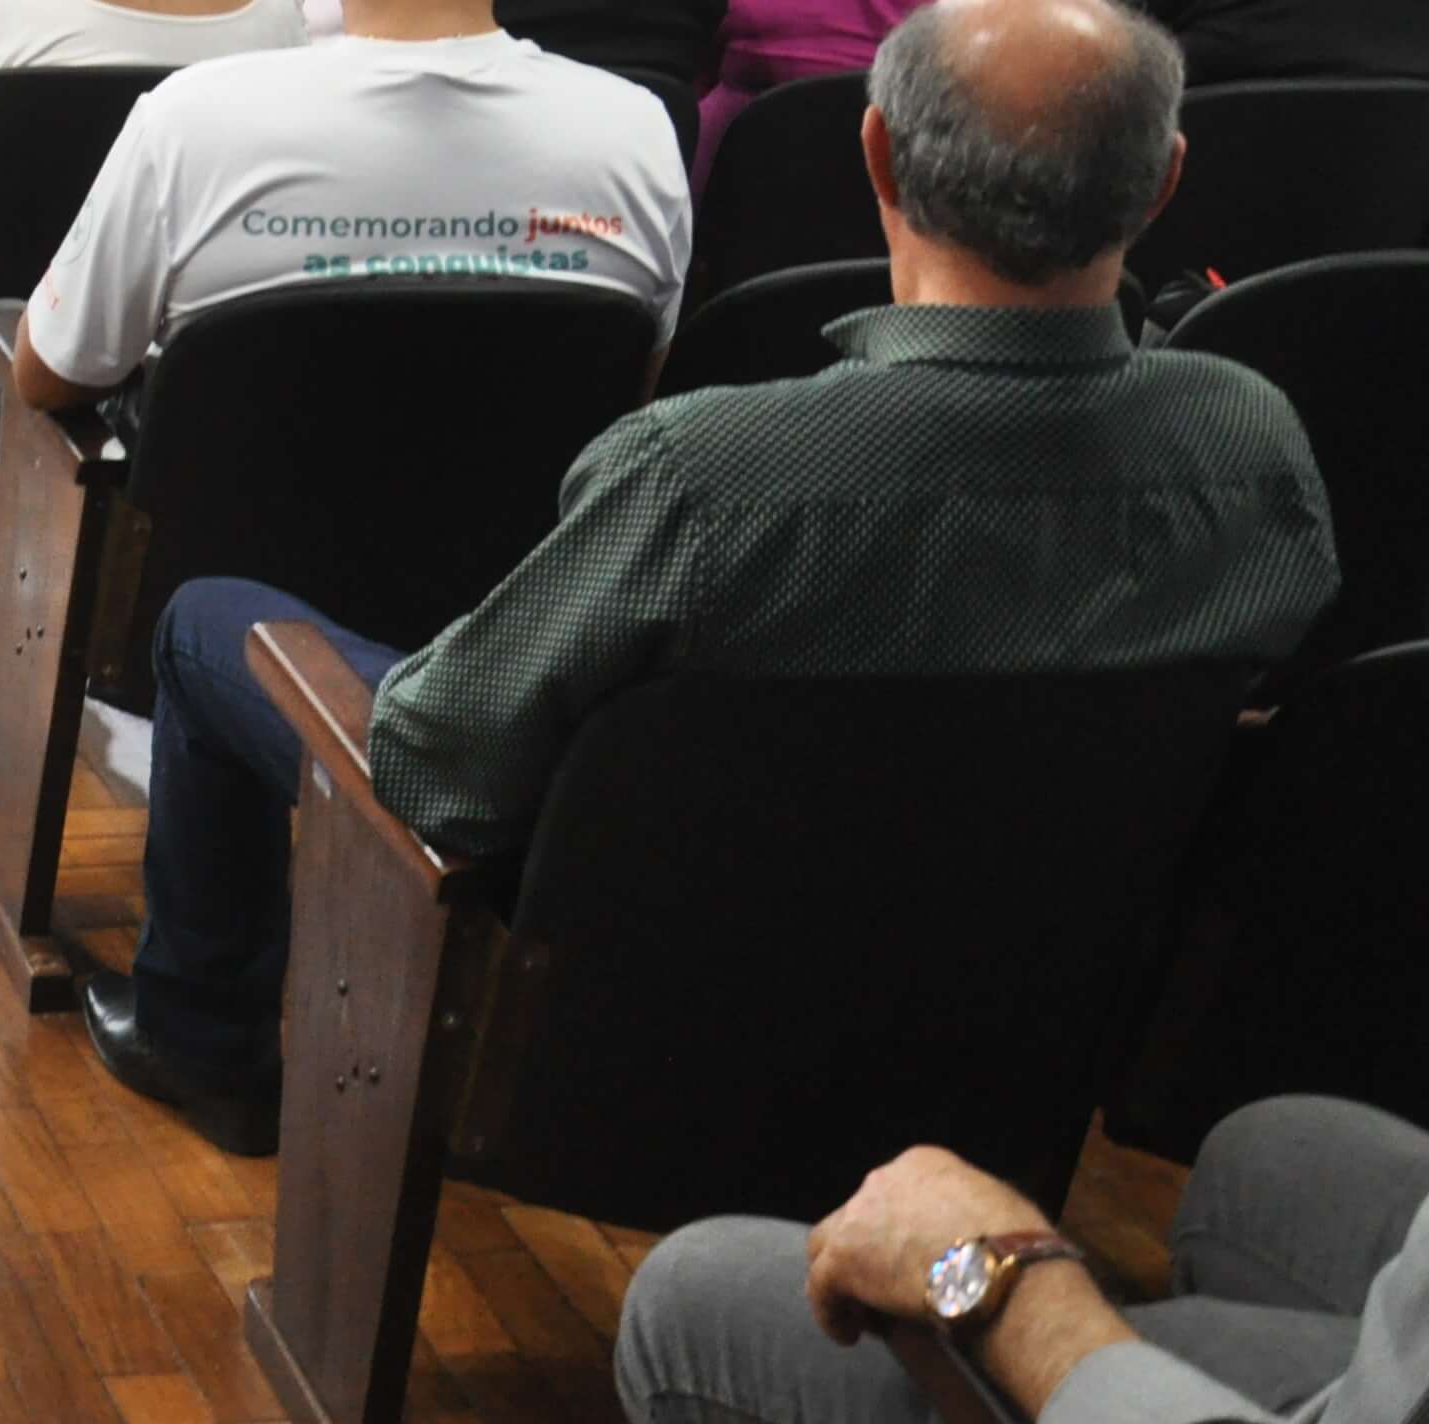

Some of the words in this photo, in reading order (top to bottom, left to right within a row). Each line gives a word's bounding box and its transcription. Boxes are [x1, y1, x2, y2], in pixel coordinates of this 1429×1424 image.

[242, 209, 519, 239] Comemorando
[525, 208, 624, 242] juntos
[302, 252, 352, 277] as
